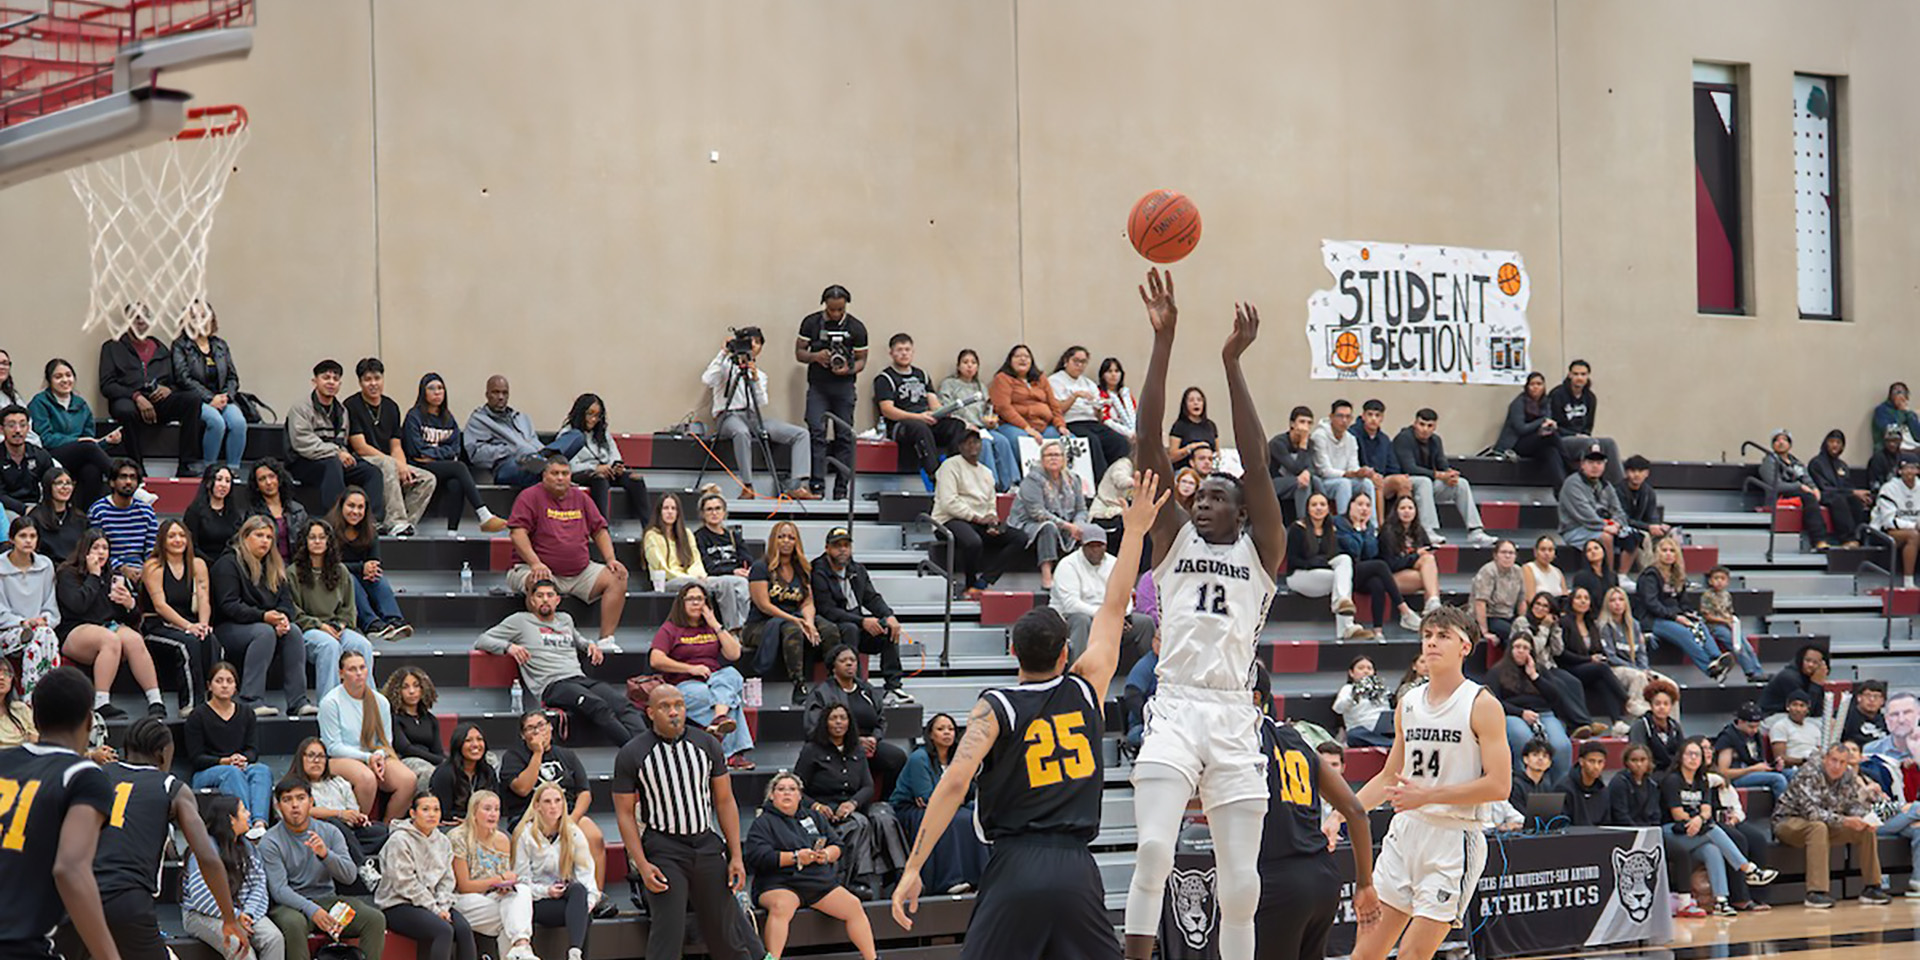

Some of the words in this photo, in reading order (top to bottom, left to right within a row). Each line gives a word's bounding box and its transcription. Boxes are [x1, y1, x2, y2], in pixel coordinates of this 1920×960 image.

[1339, 270, 1490, 327] STUDENT
[1370, 323, 1473, 373] SECTION
[1174, 559, 1250, 581] JAGUARS
[1195, 582, 1228, 616] 12
[1024, 710, 1096, 789] 25
[1412, 749, 1440, 777] 24
[1273, 745, 1313, 807] 10
[1571, 865, 1600, 881] ANTONIO
[1480, 885, 1600, 917] ATHLETICS
